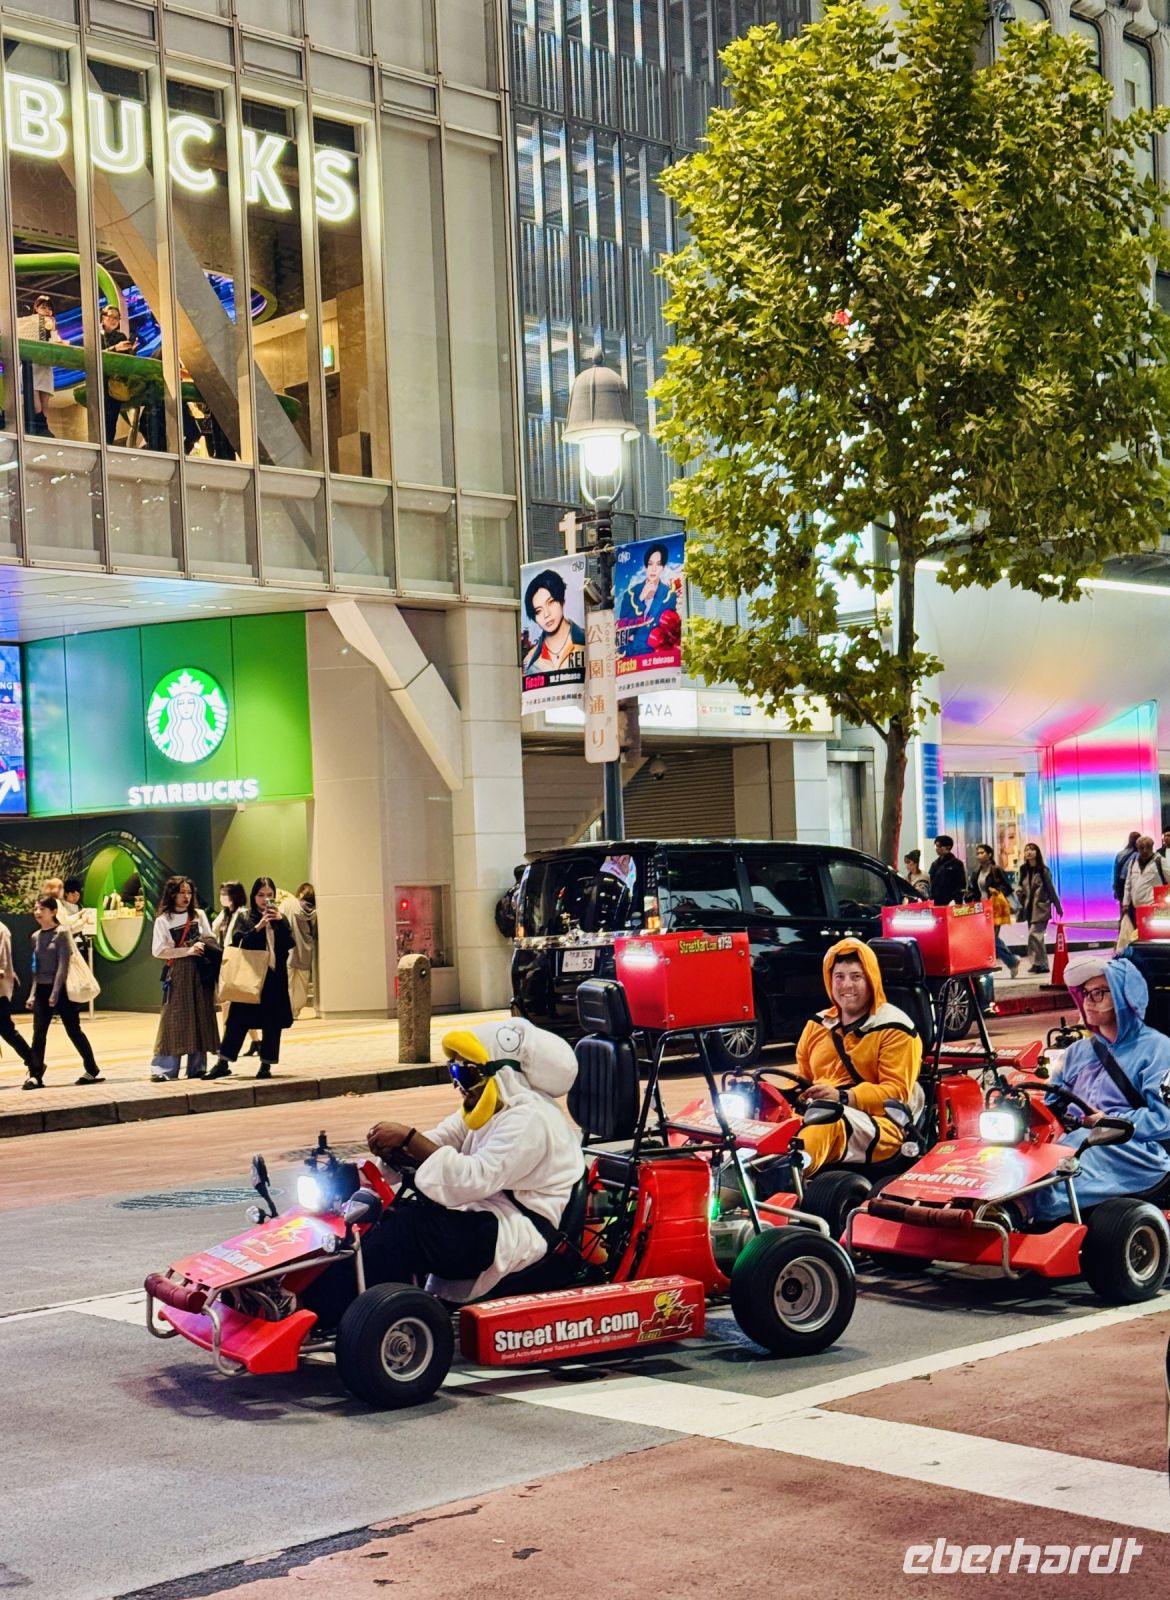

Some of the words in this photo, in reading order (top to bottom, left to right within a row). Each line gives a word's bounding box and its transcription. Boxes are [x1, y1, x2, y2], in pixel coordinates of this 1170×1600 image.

[4, 71, 357, 222] BUCKS
[616, 658, 638, 675] Fiesta
[587, 624, 605, 748] 公園通り
[128, 779, 259, 806] STARBUCKS
[582, 957, 593, 969] 59
[494, 1326, 552, 1352] Street
[555, 1317, 594, 1342] Kart
[596, 1310, 639, 1335] .com
